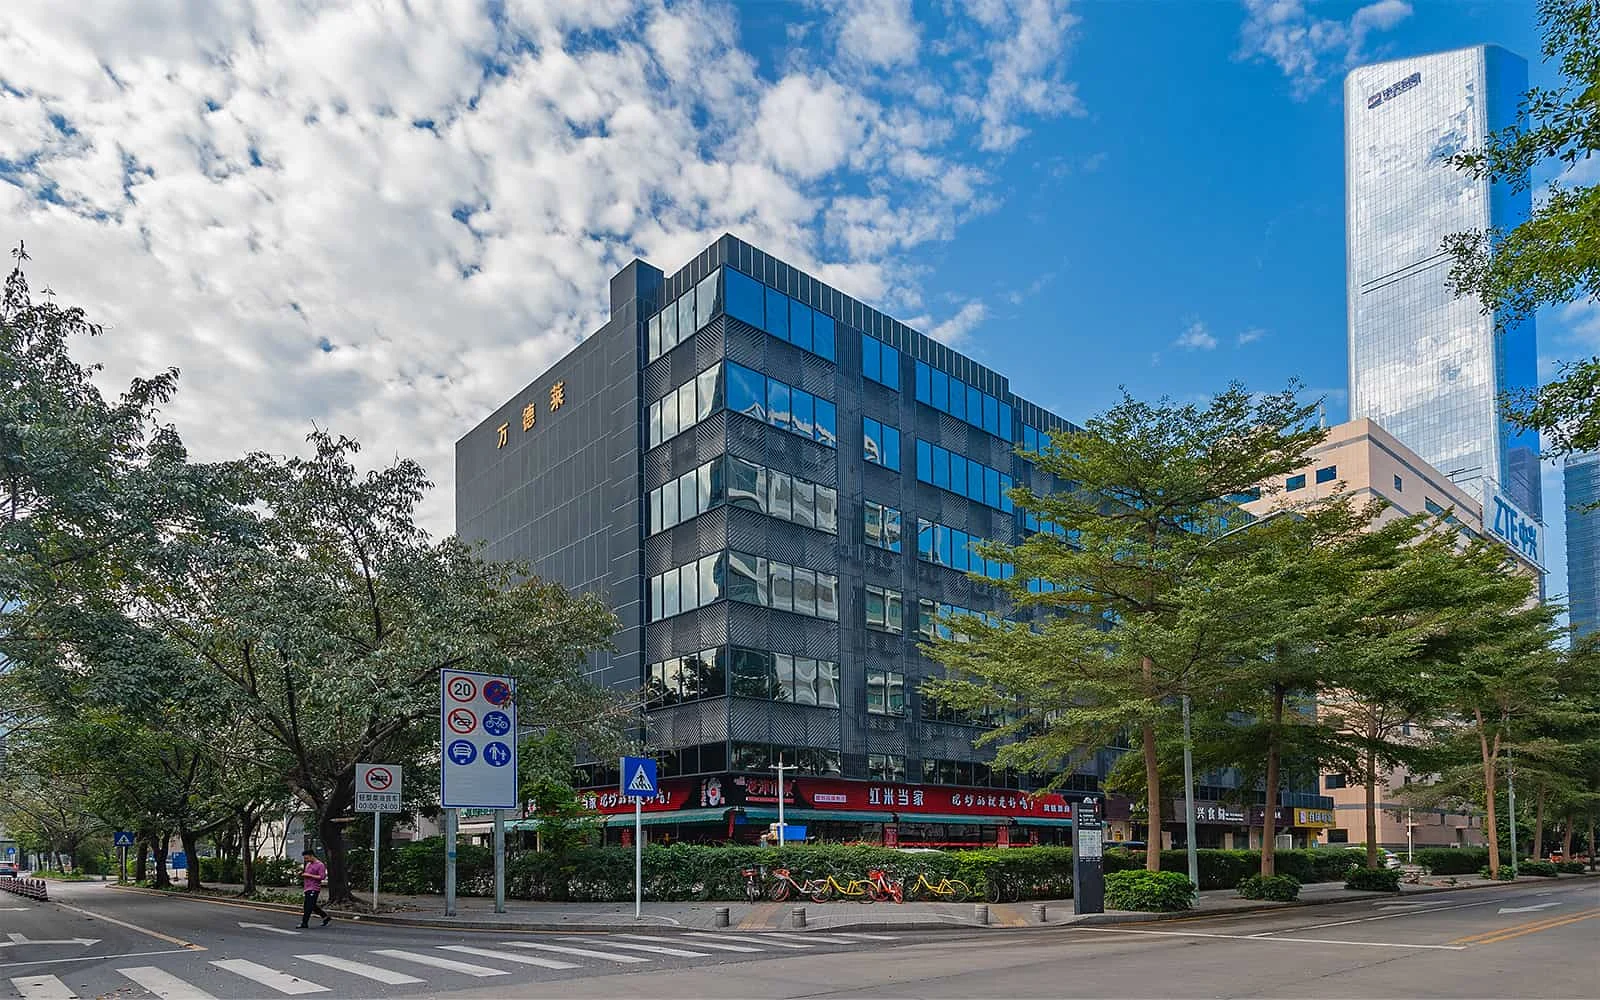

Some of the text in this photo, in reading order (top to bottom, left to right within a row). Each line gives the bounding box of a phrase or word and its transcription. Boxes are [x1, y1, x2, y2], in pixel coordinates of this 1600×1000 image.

[454, 682, 471, 697] 20
[869, 787, 924, 806] 红米当家
